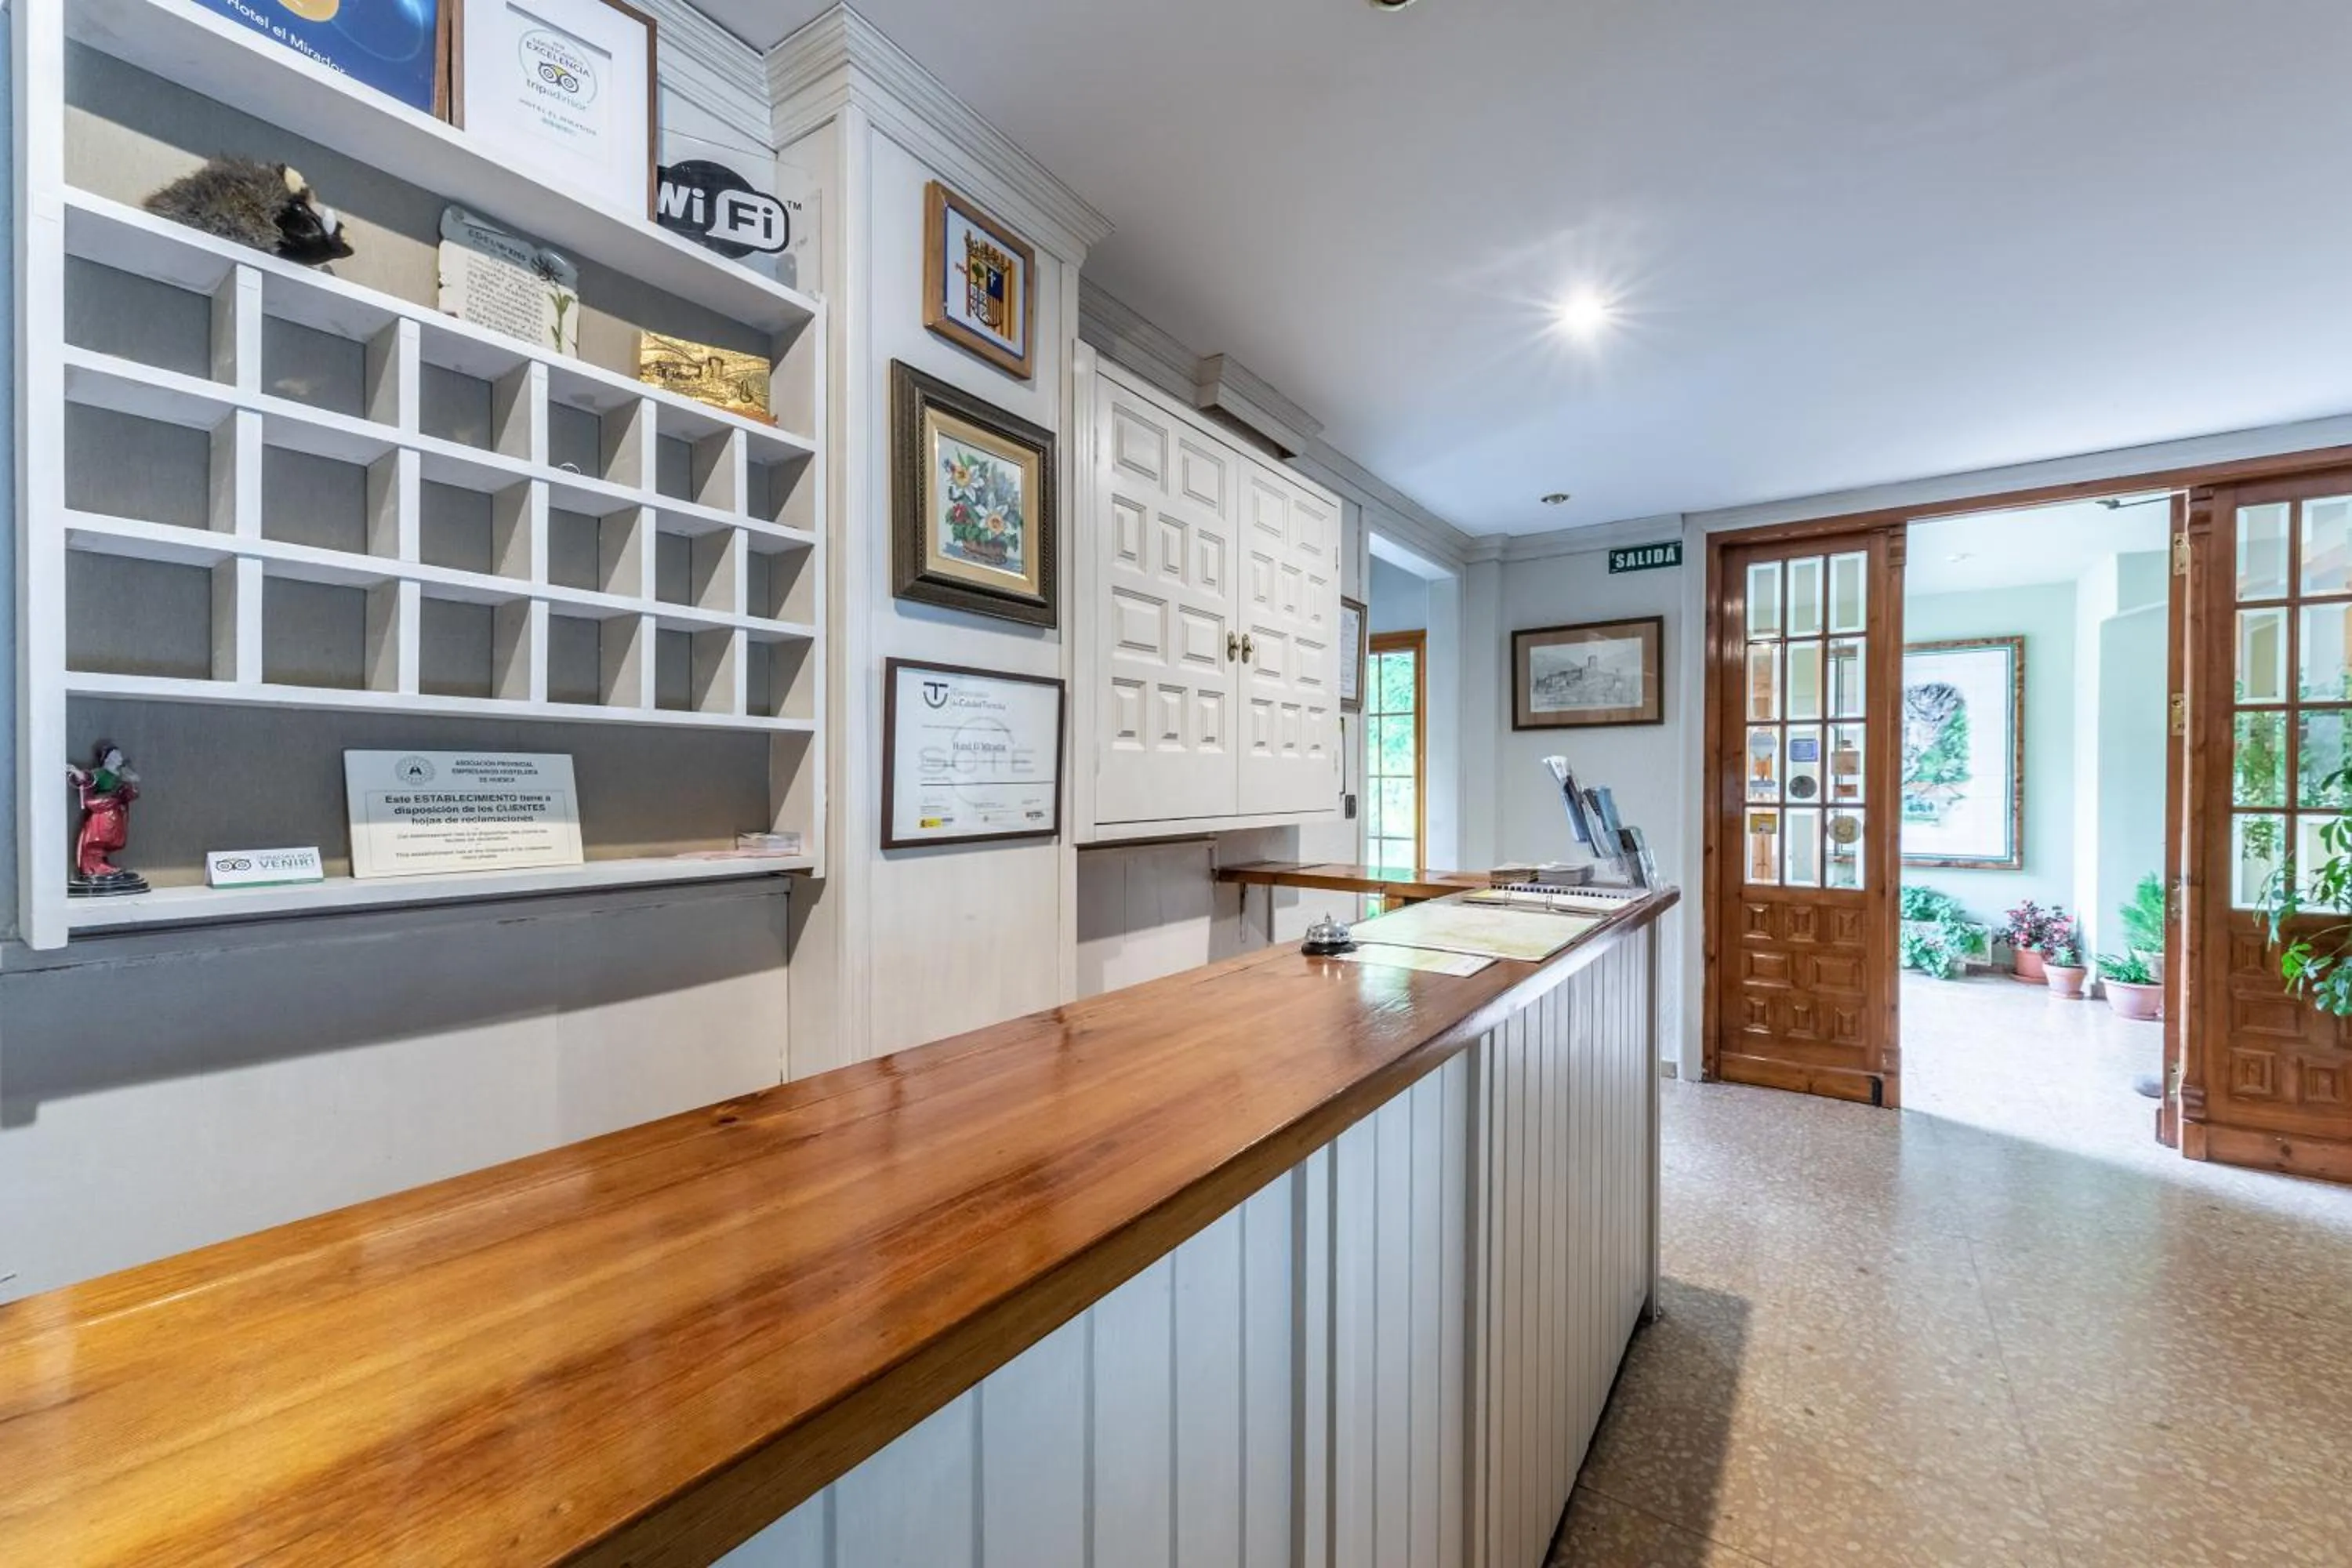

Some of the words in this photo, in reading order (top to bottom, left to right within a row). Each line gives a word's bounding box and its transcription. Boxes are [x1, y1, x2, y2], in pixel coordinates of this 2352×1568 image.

[272, 25, 286, 39] el
[526, 40, 590, 78] EXCELENCIA
[526, 78, 587, 110] tripadvisor
[1615, 546, 1676, 568] SALIDA
[385, 794, 412, 804] Este
[414, 793, 517, 804] ESTABLECIMIENTO
[520, 793, 543, 803] tiene
[394, 804, 459, 816] disposición
[462, 804, 475, 814] de
[477, 804, 494, 814] los
[496, 803, 546, 813] CLIENTES
[412, 815, 442, 826] hojas
[445, 815, 459, 824] de
[460, 814, 535, 824] reclamaciones
